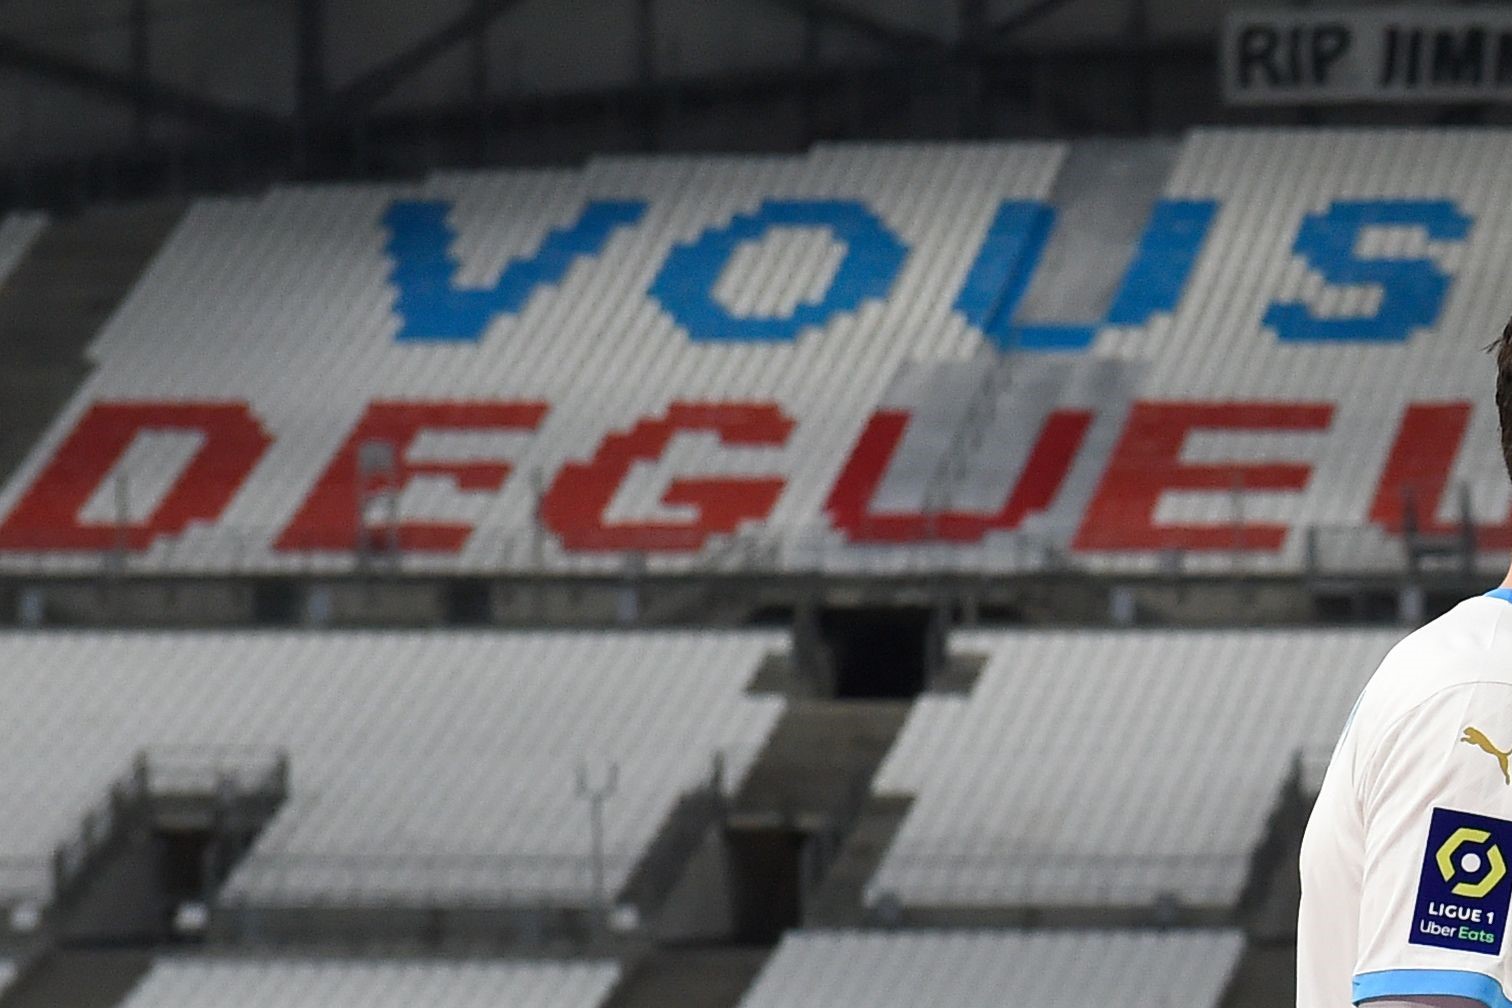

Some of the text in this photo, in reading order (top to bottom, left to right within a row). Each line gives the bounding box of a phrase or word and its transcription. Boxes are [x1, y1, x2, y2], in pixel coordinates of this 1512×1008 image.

[1236, 22, 1353, 90] RIP
[380, 197, 1476, 350] VOUS
[1419, 919, 1496, 944] Uber Eats
[1428, 902, 1496, 925] LIGUE 1
